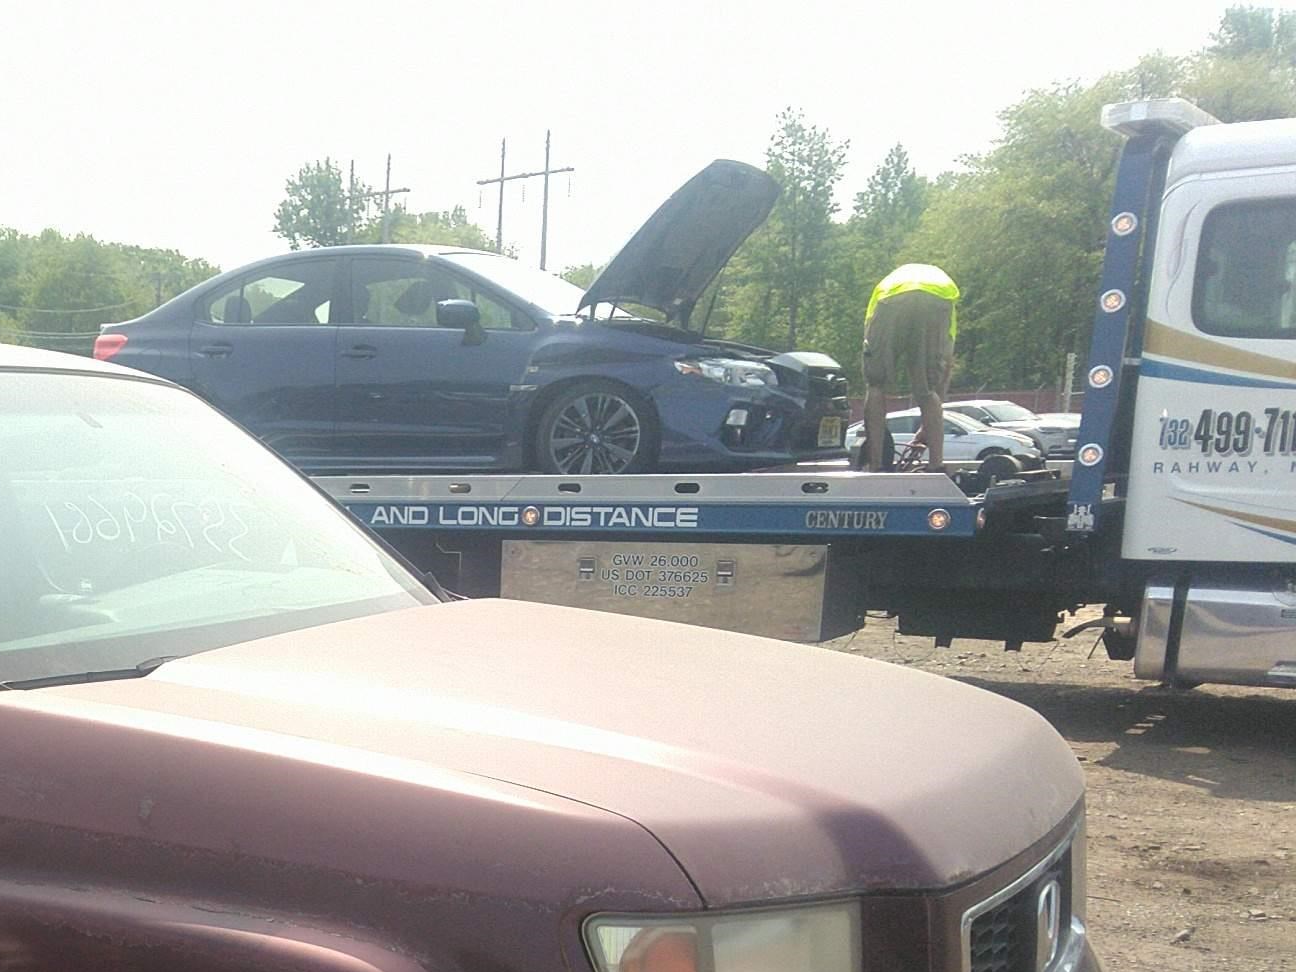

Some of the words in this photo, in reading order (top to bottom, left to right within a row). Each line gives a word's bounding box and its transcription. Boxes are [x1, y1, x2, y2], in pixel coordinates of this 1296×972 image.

[1159, 417, 1192, 449] 732
[370, 506, 429, 526] AND
[439, 506, 519, 526] LONG
[543, 507, 699, 527] DISTANCE
[805, 510, 889, 529] CENTURY
[612, 554, 644, 566] GVW
[601, 569, 619, 581] US
[625, 570, 652, 581] DOT
[658, 570, 708, 583] 376625
[614, 584, 637, 596] ICC
[644, 585, 693, 598] 225537
